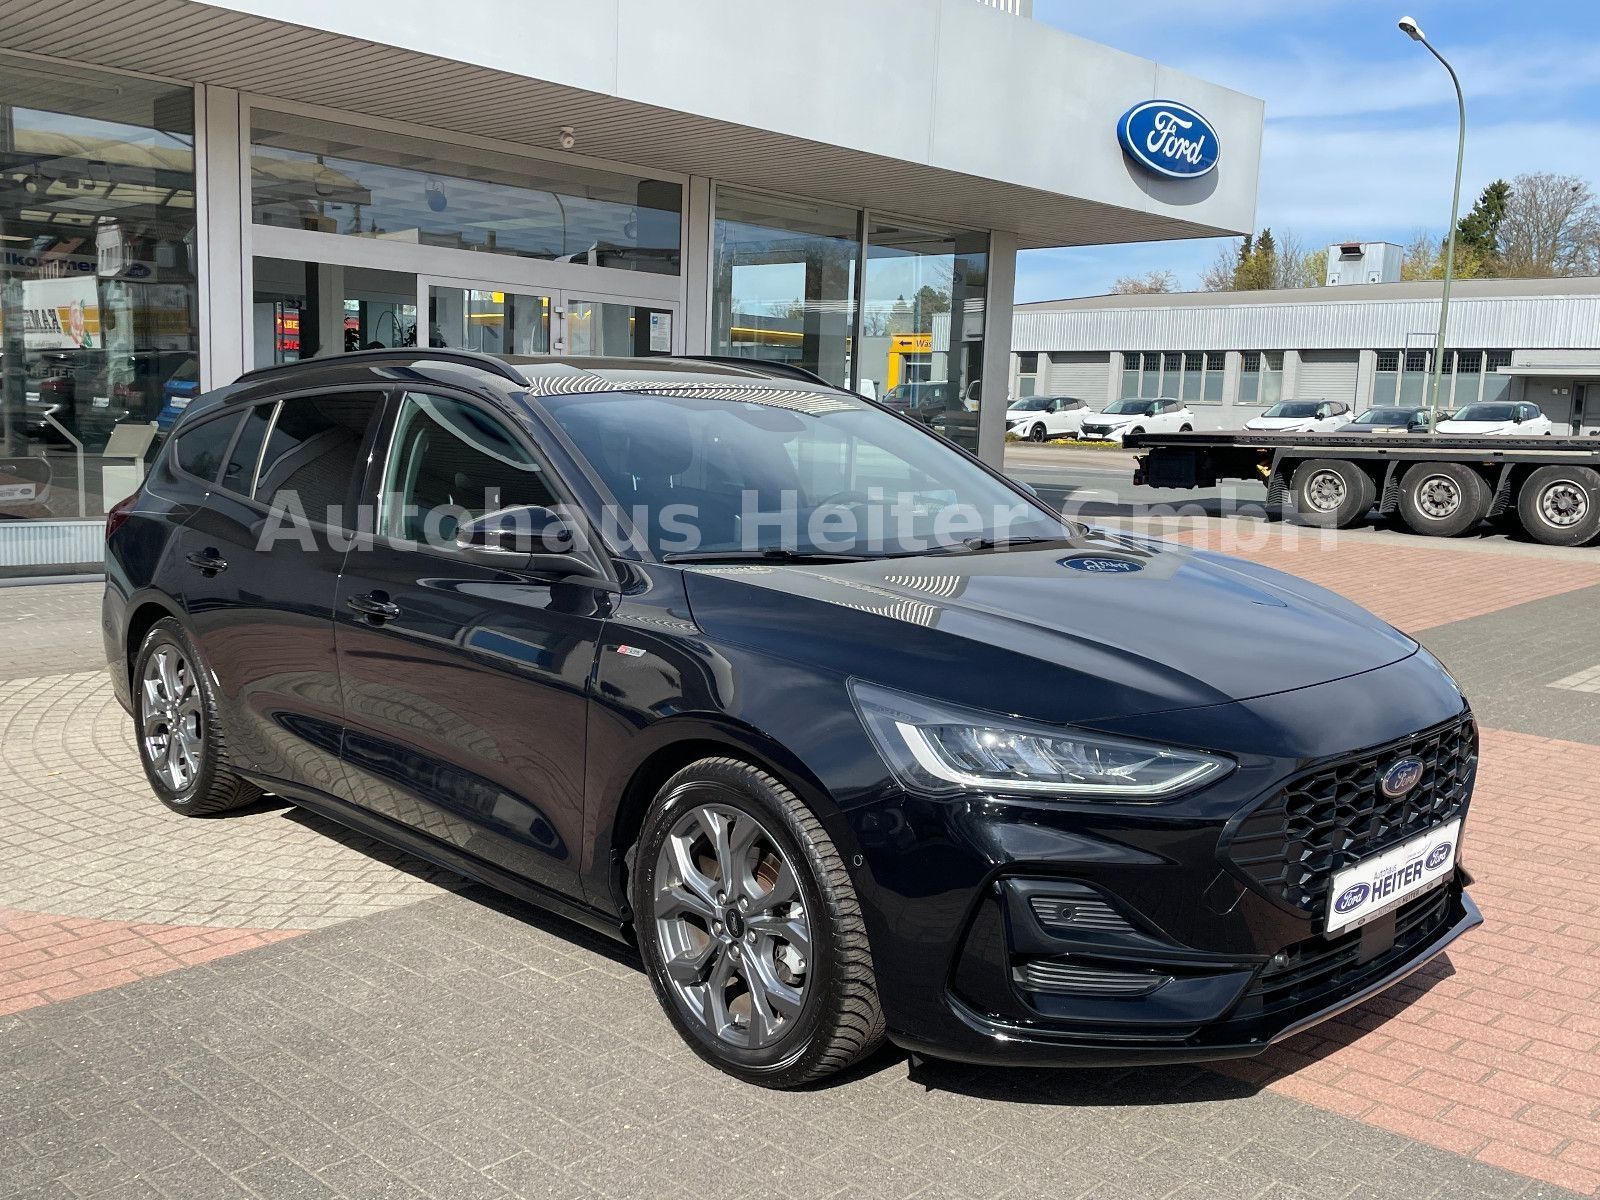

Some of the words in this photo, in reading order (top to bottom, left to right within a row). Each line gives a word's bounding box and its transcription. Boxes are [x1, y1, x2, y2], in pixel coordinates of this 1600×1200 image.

[1146, 111, 1206, 165] Ford
[1340, 886, 1365, 910] Ford
[1371, 860, 1423, 903] HEITER
